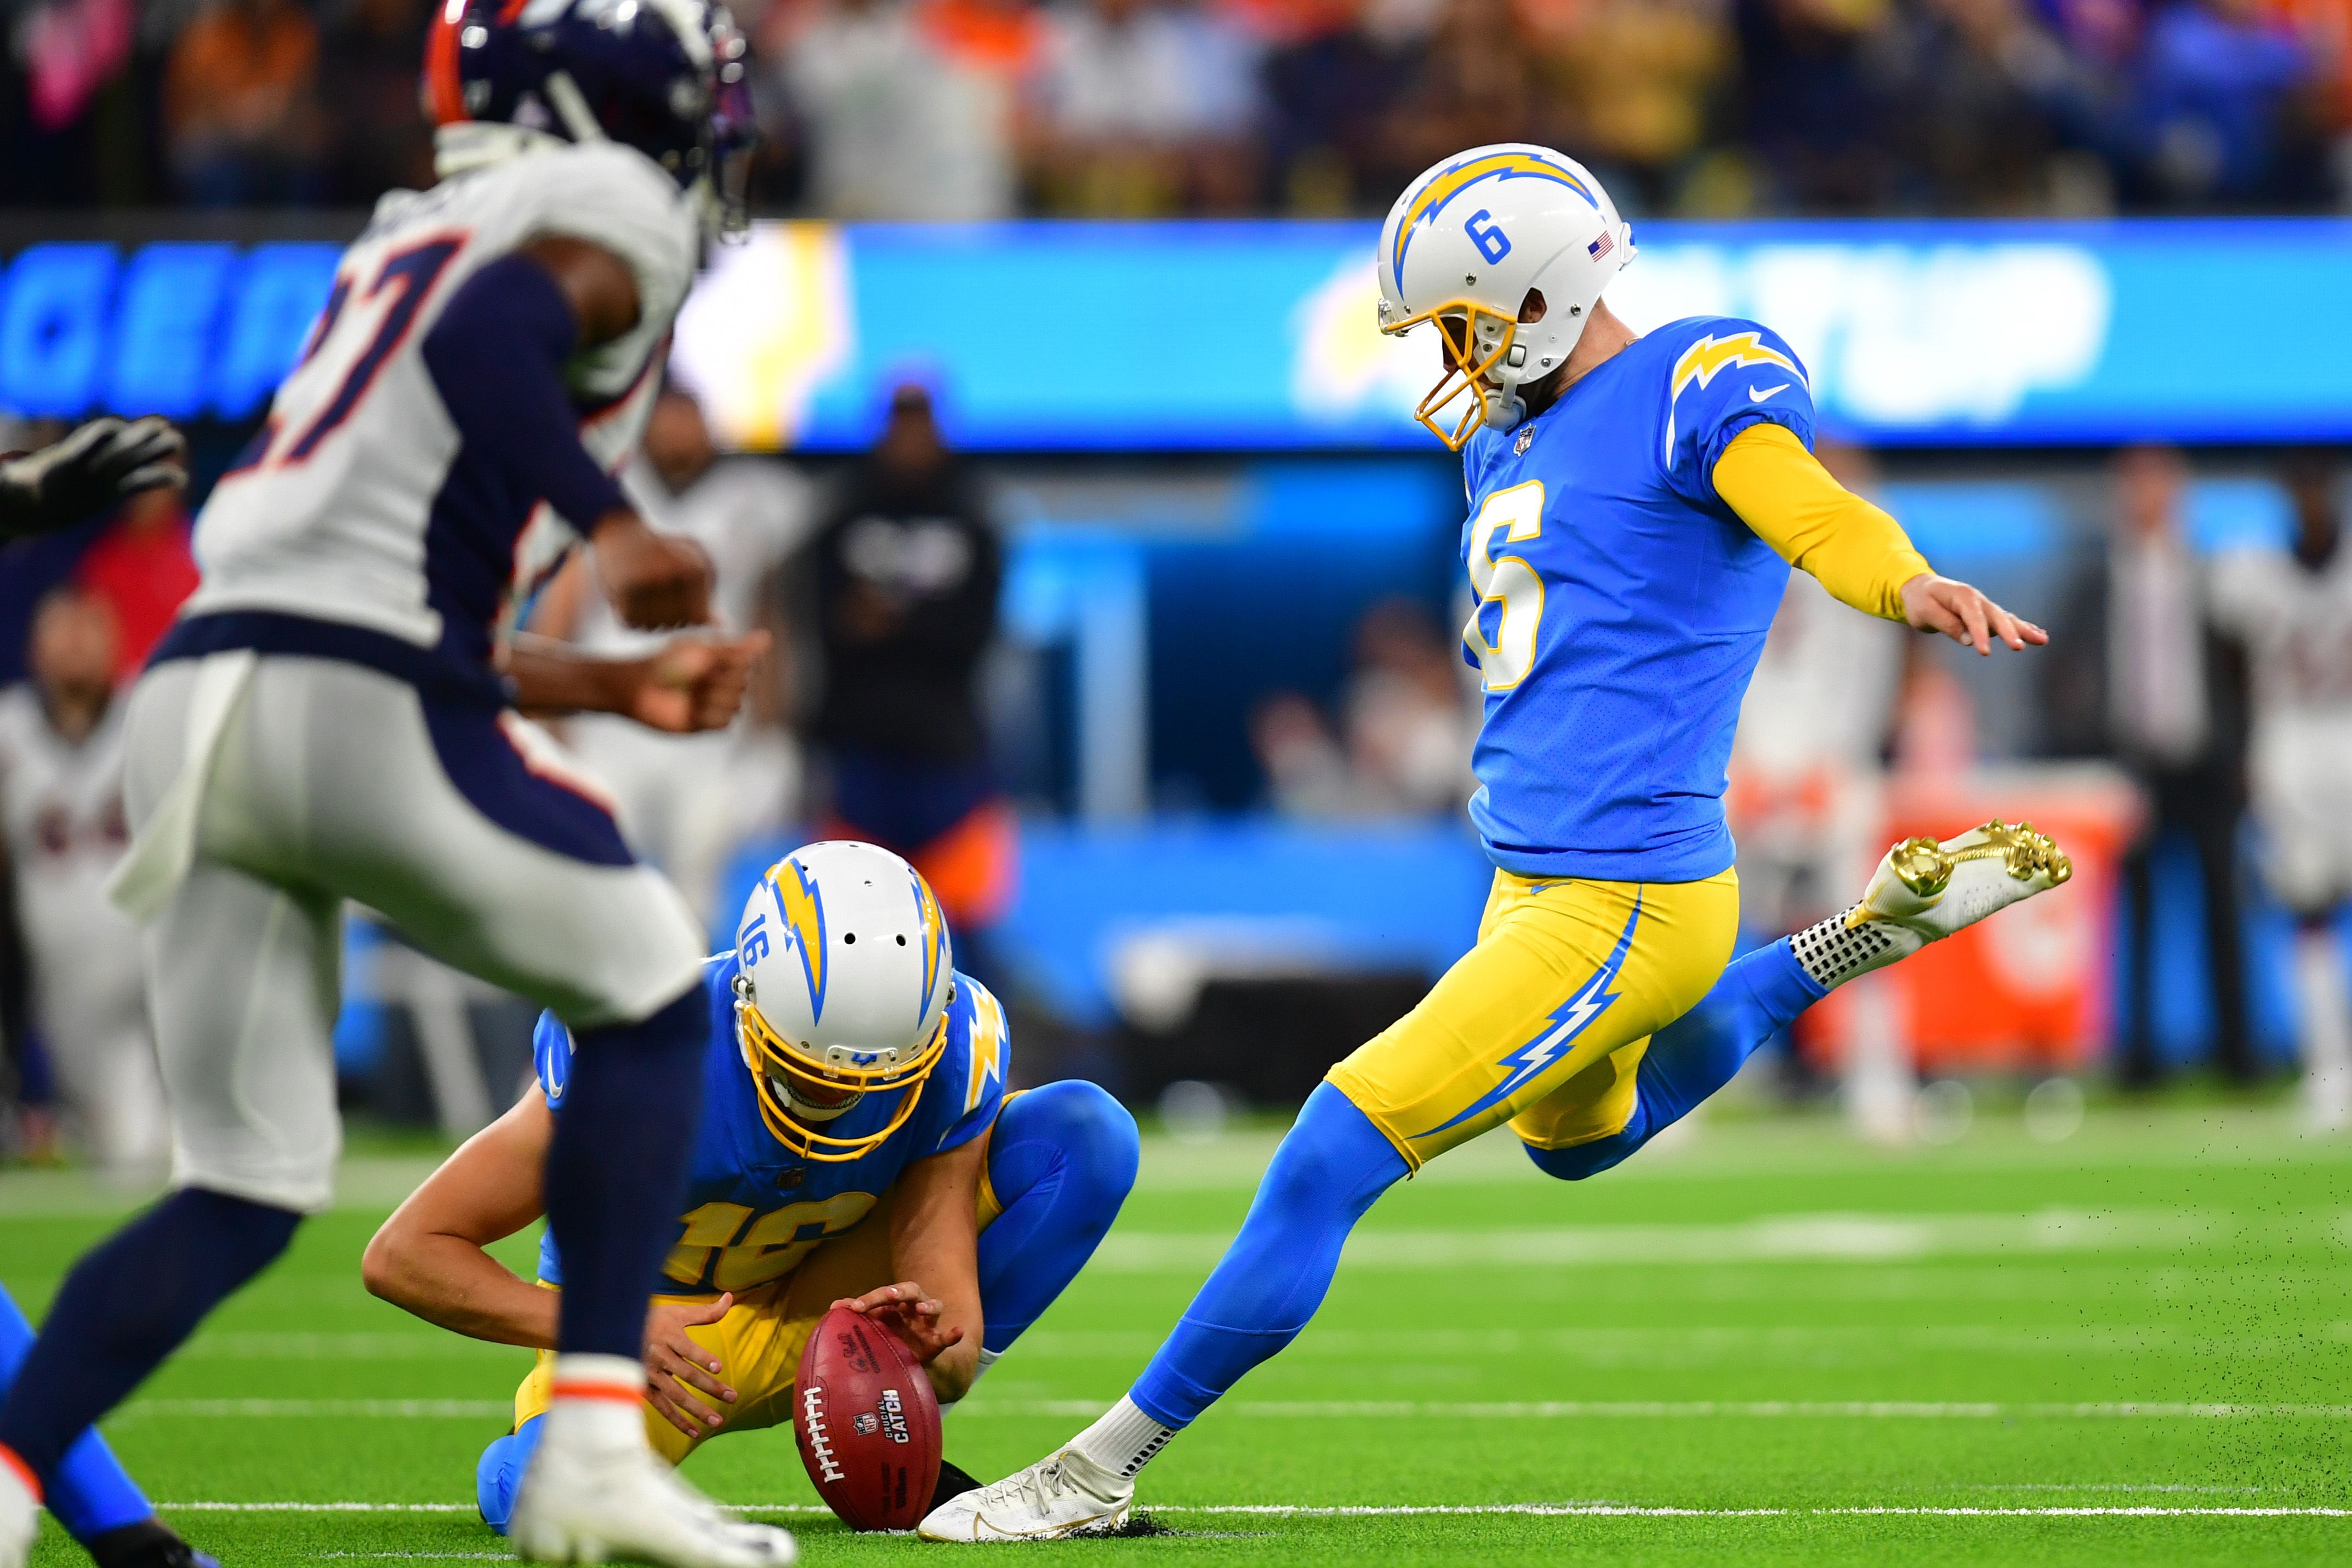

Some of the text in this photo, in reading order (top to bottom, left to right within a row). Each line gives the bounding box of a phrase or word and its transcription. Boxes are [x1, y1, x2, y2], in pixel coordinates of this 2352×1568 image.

[1464, 209, 1512, 265] 6
[1462, 478, 1546, 691] 6
[741, 913, 770, 971] 16
[661, 1191, 878, 1292] 16
[863, 1415, 876, 1431] NFL
[877, 1400, 893, 1438] CRUCIAL
[882, 1389, 909, 1444] CATCH
